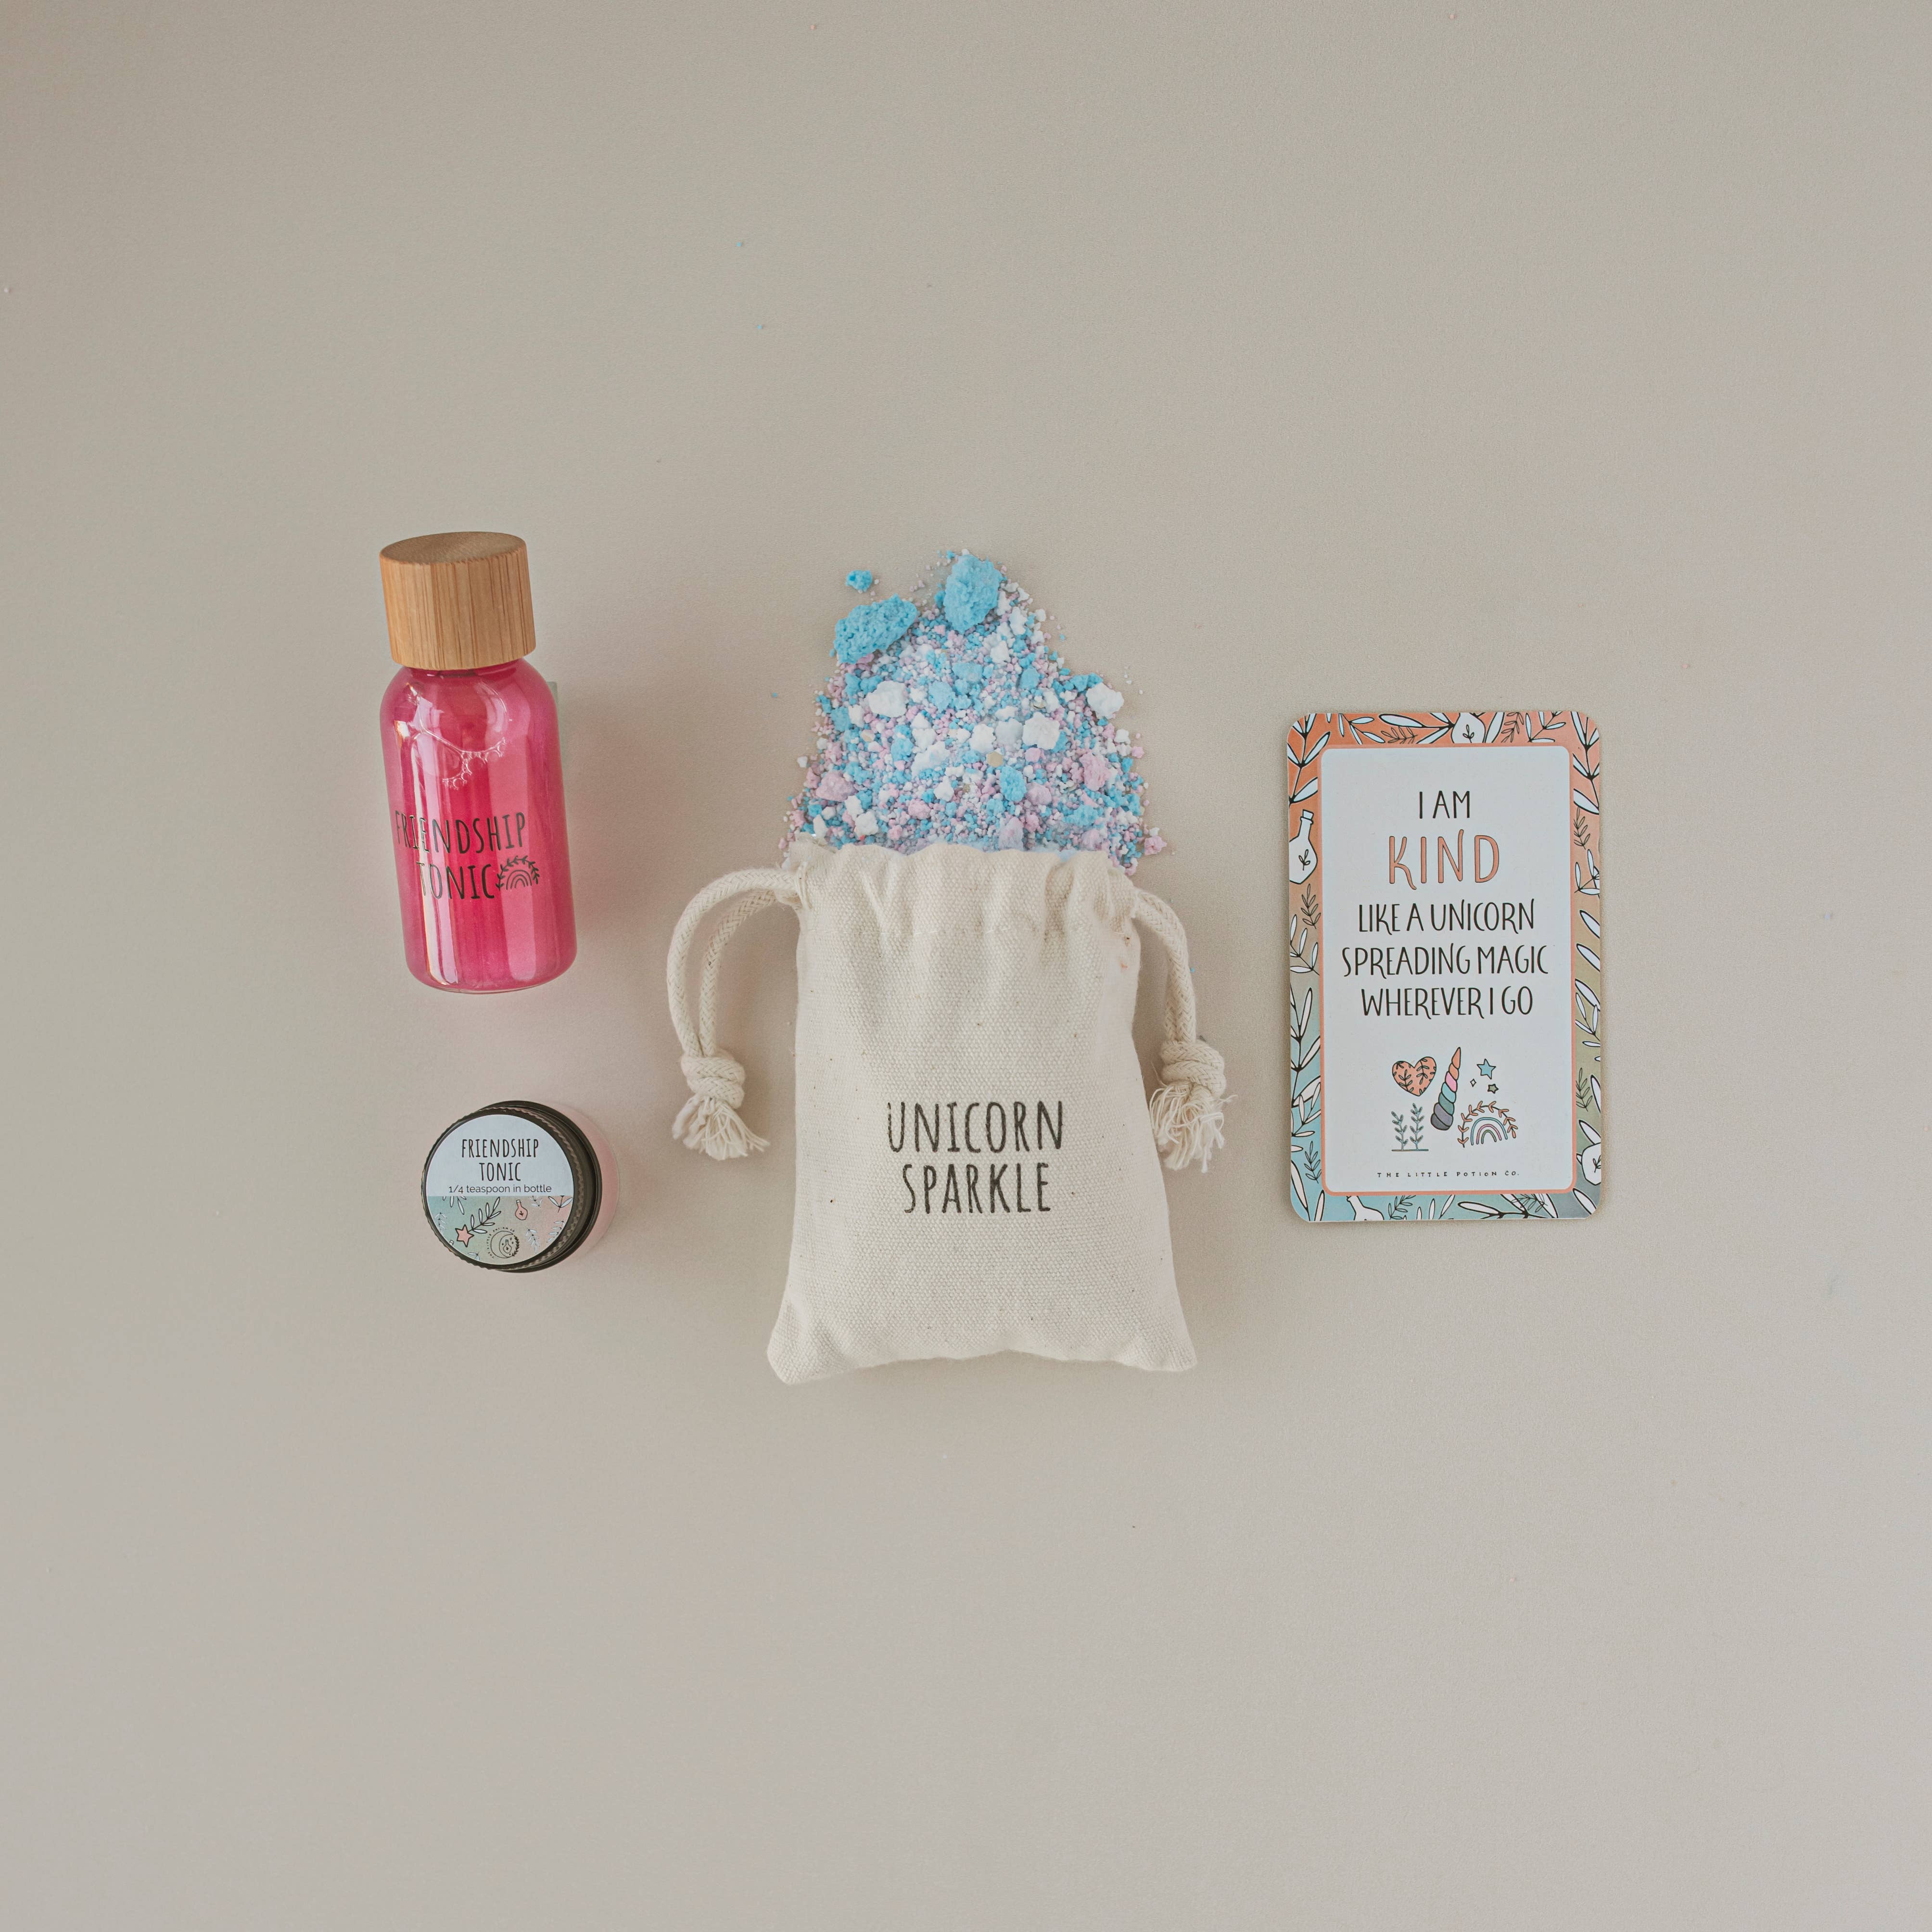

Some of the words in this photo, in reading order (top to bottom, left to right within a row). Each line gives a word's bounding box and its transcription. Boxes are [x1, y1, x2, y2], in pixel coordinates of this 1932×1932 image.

[1418, 791, 1424, 819] I
[1432, 790, 1470, 819] AM
[394, 810, 526, 854] FRIENDSHIP
[1389, 829, 1500, 890] KIND
[416, 861, 496, 900] TONIC
[1359, 903, 1401, 936] LIKE
[1406, 902, 1424, 931] A
[1430, 898, 1535, 934] UNICORN
[1342, 942, 1471, 979] SPREADING
[1477, 944, 1549, 974] MAGIC
[1361, 987, 1485, 1020] WHEREVER
[1489, 987, 1494, 1015] I
[1501, 986, 1533, 1015] GO
[887, 1100, 1064, 1154] UNICORN
[461, 1138, 539, 1158] FRIENDSHIP
[448, 1184, 464, 1194] 1/4
[466, 1185, 510, 1195] teaspoon
[513, 1184, 521, 1193] in
[524, 1184, 552, 1193] bottle
[478, 1162, 521, 1182] TONIC
[902, 1162, 1051, 1214] SPARKLE
